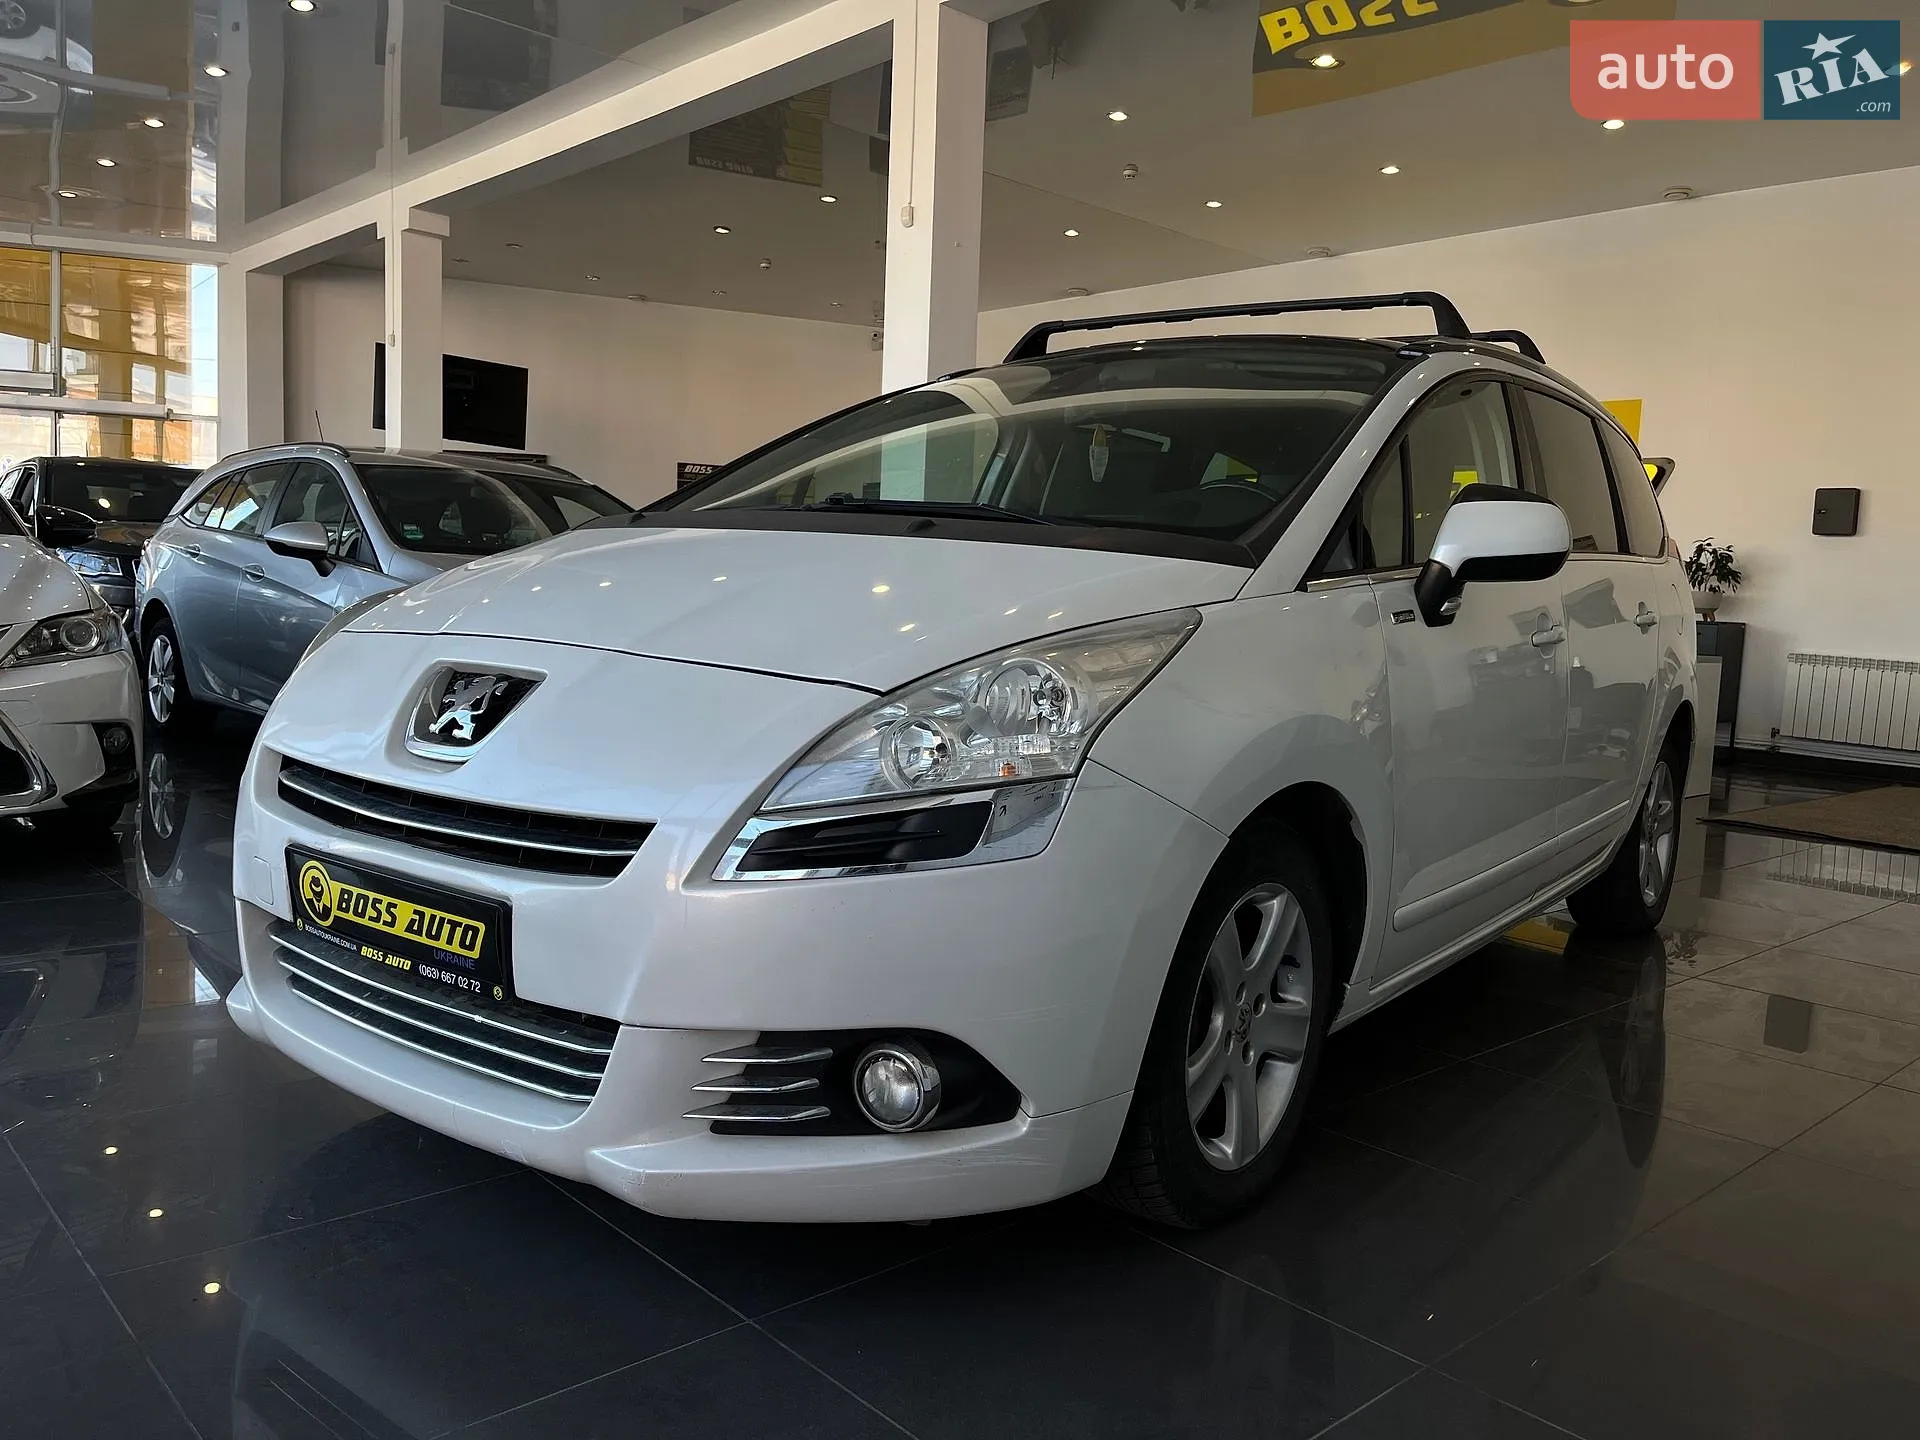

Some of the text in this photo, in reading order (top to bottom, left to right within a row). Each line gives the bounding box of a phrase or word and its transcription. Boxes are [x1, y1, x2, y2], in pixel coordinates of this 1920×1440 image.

[685, 465, 713, 474] BOSS
[336, 887, 481, 953] BOSS AUTO
[361, 945, 412, 971] BOSS AUTO
[433, 948, 477, 970] UKRAINE
[418, 963, 481, 993] (063) 667 02 72
